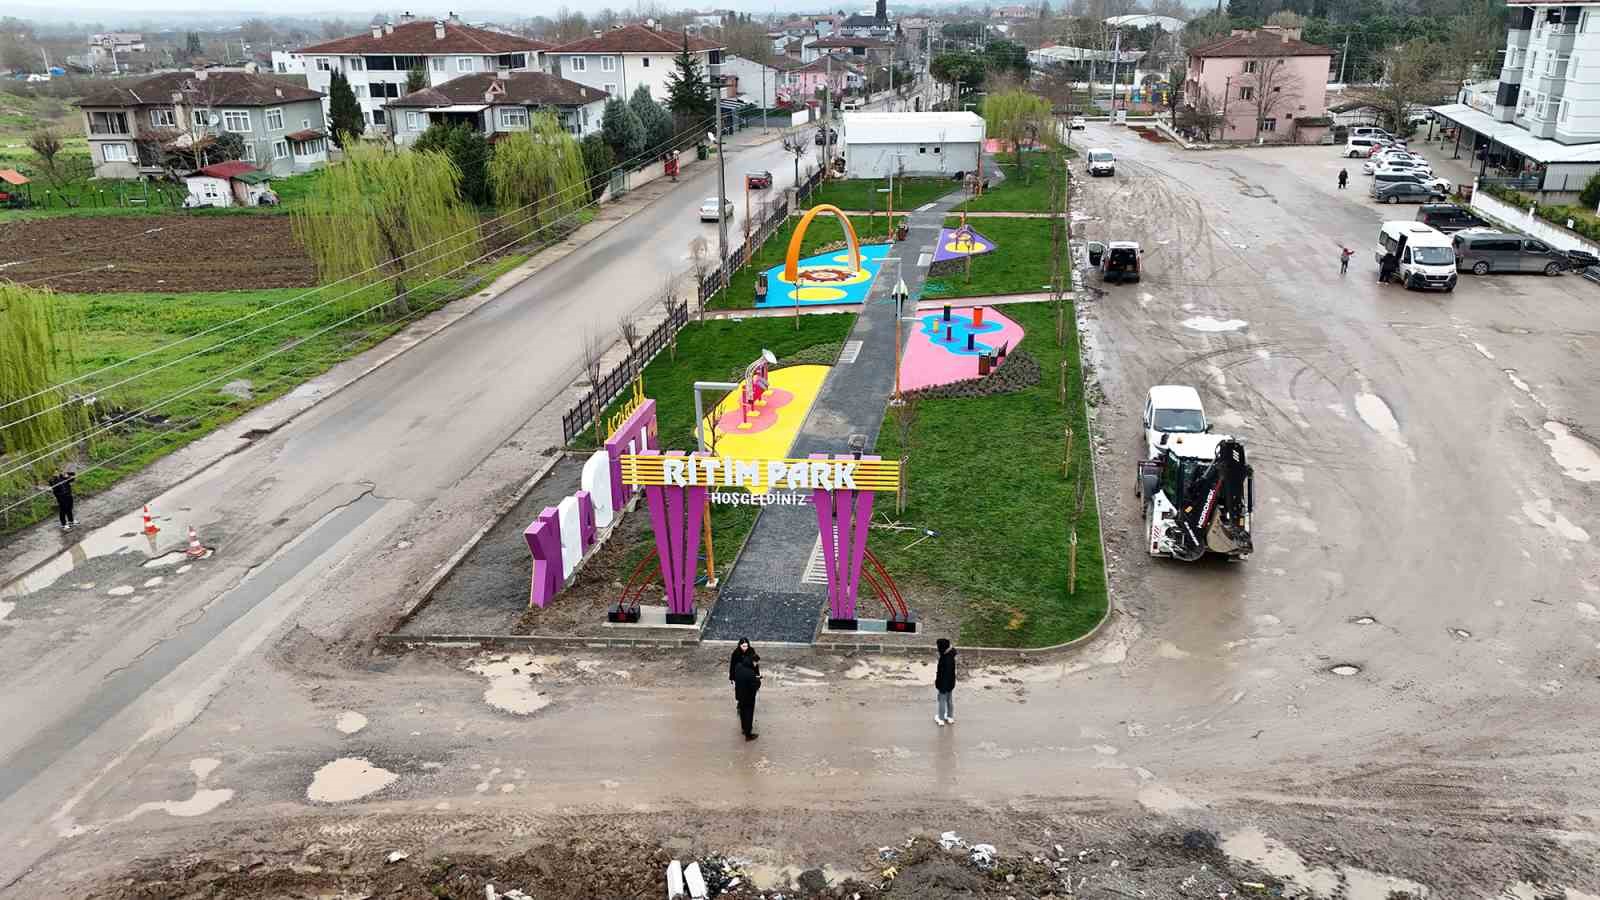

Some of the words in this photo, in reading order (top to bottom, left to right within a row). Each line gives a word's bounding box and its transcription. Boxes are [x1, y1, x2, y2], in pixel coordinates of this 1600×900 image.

[663, 454, 760, 487] RİTİM
[768, 462, 856, 490] PARK
[711, 491, 807, 507] HOŞGELDİNİZ
